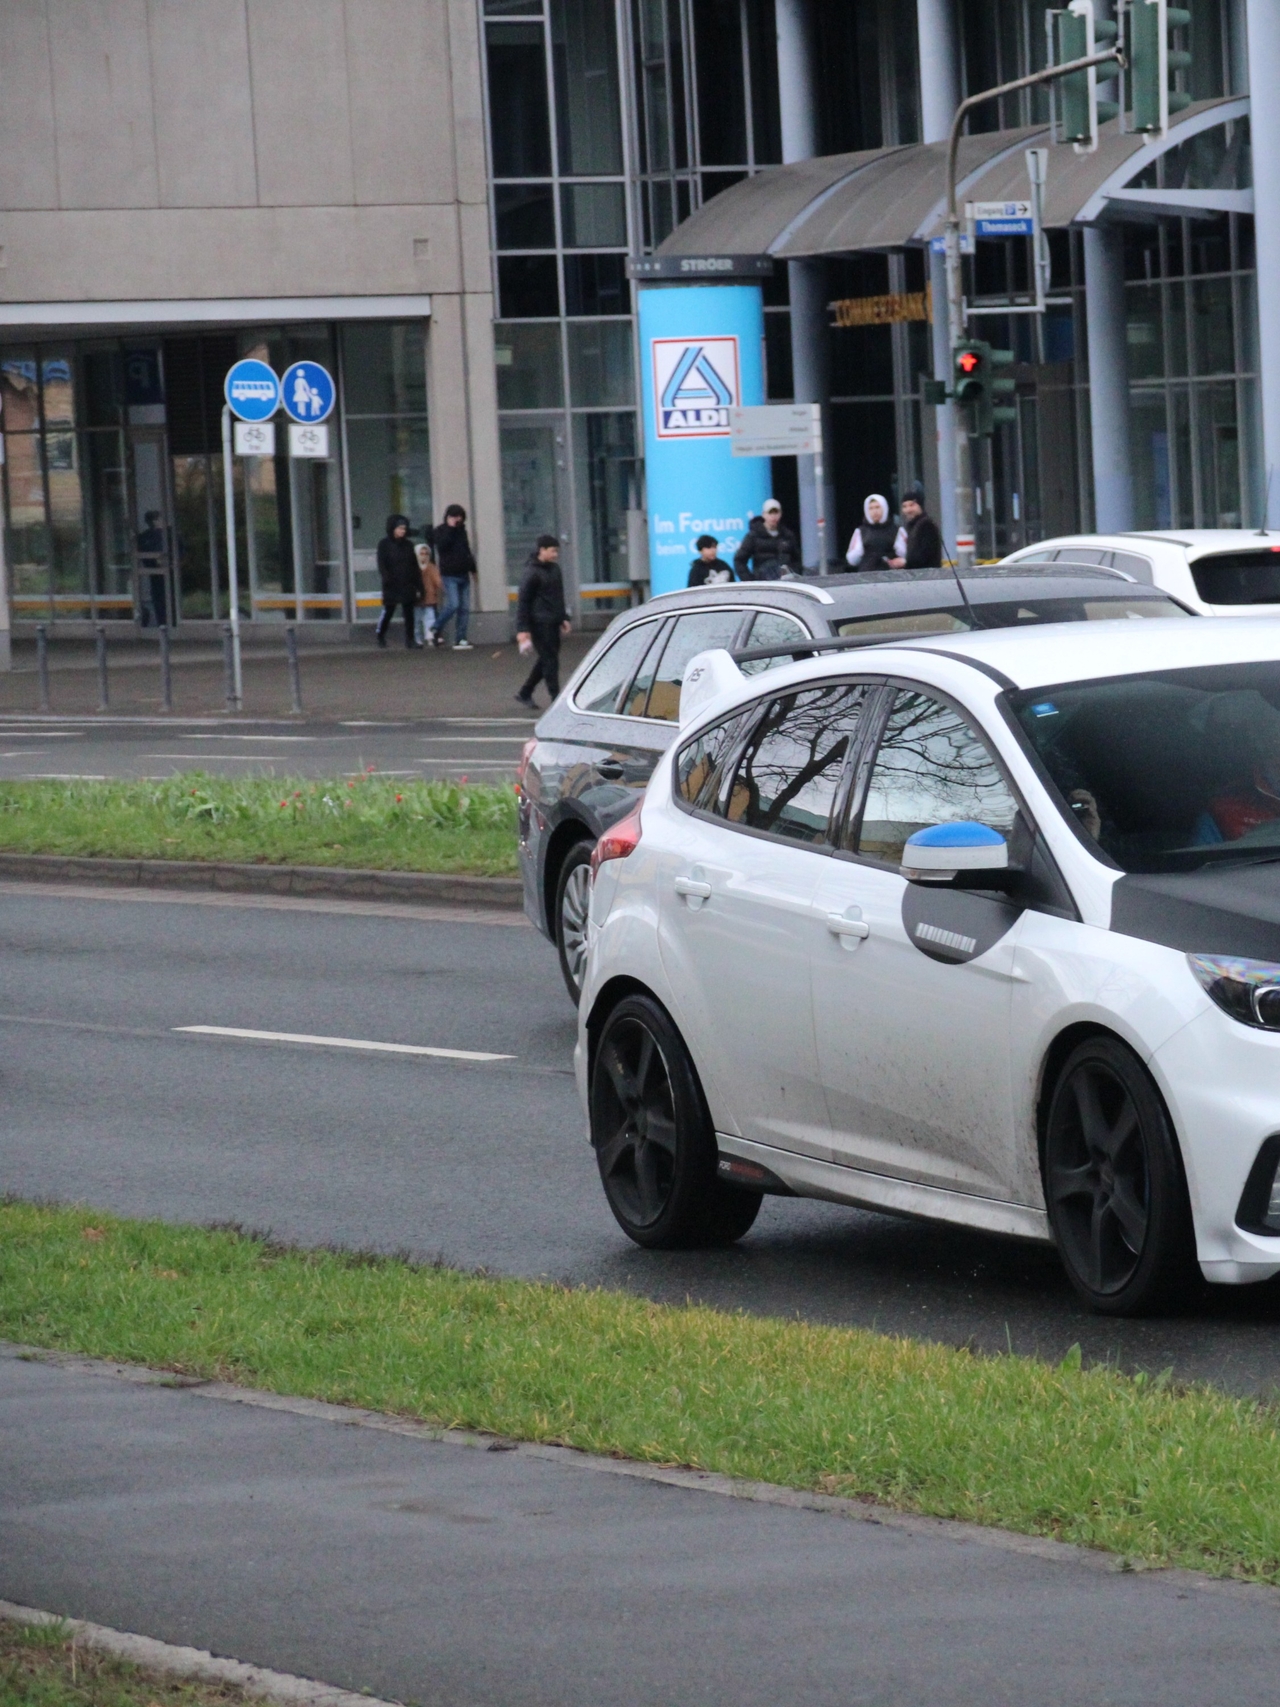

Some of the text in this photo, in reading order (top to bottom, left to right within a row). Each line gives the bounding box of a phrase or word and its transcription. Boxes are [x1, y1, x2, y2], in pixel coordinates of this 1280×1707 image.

[681, 257, 733, 271] STRÖER
[667, 409, 728, 429] ALDI
[653, 513, 675, 534] Im
[678, 512, 744, 533] Forum
